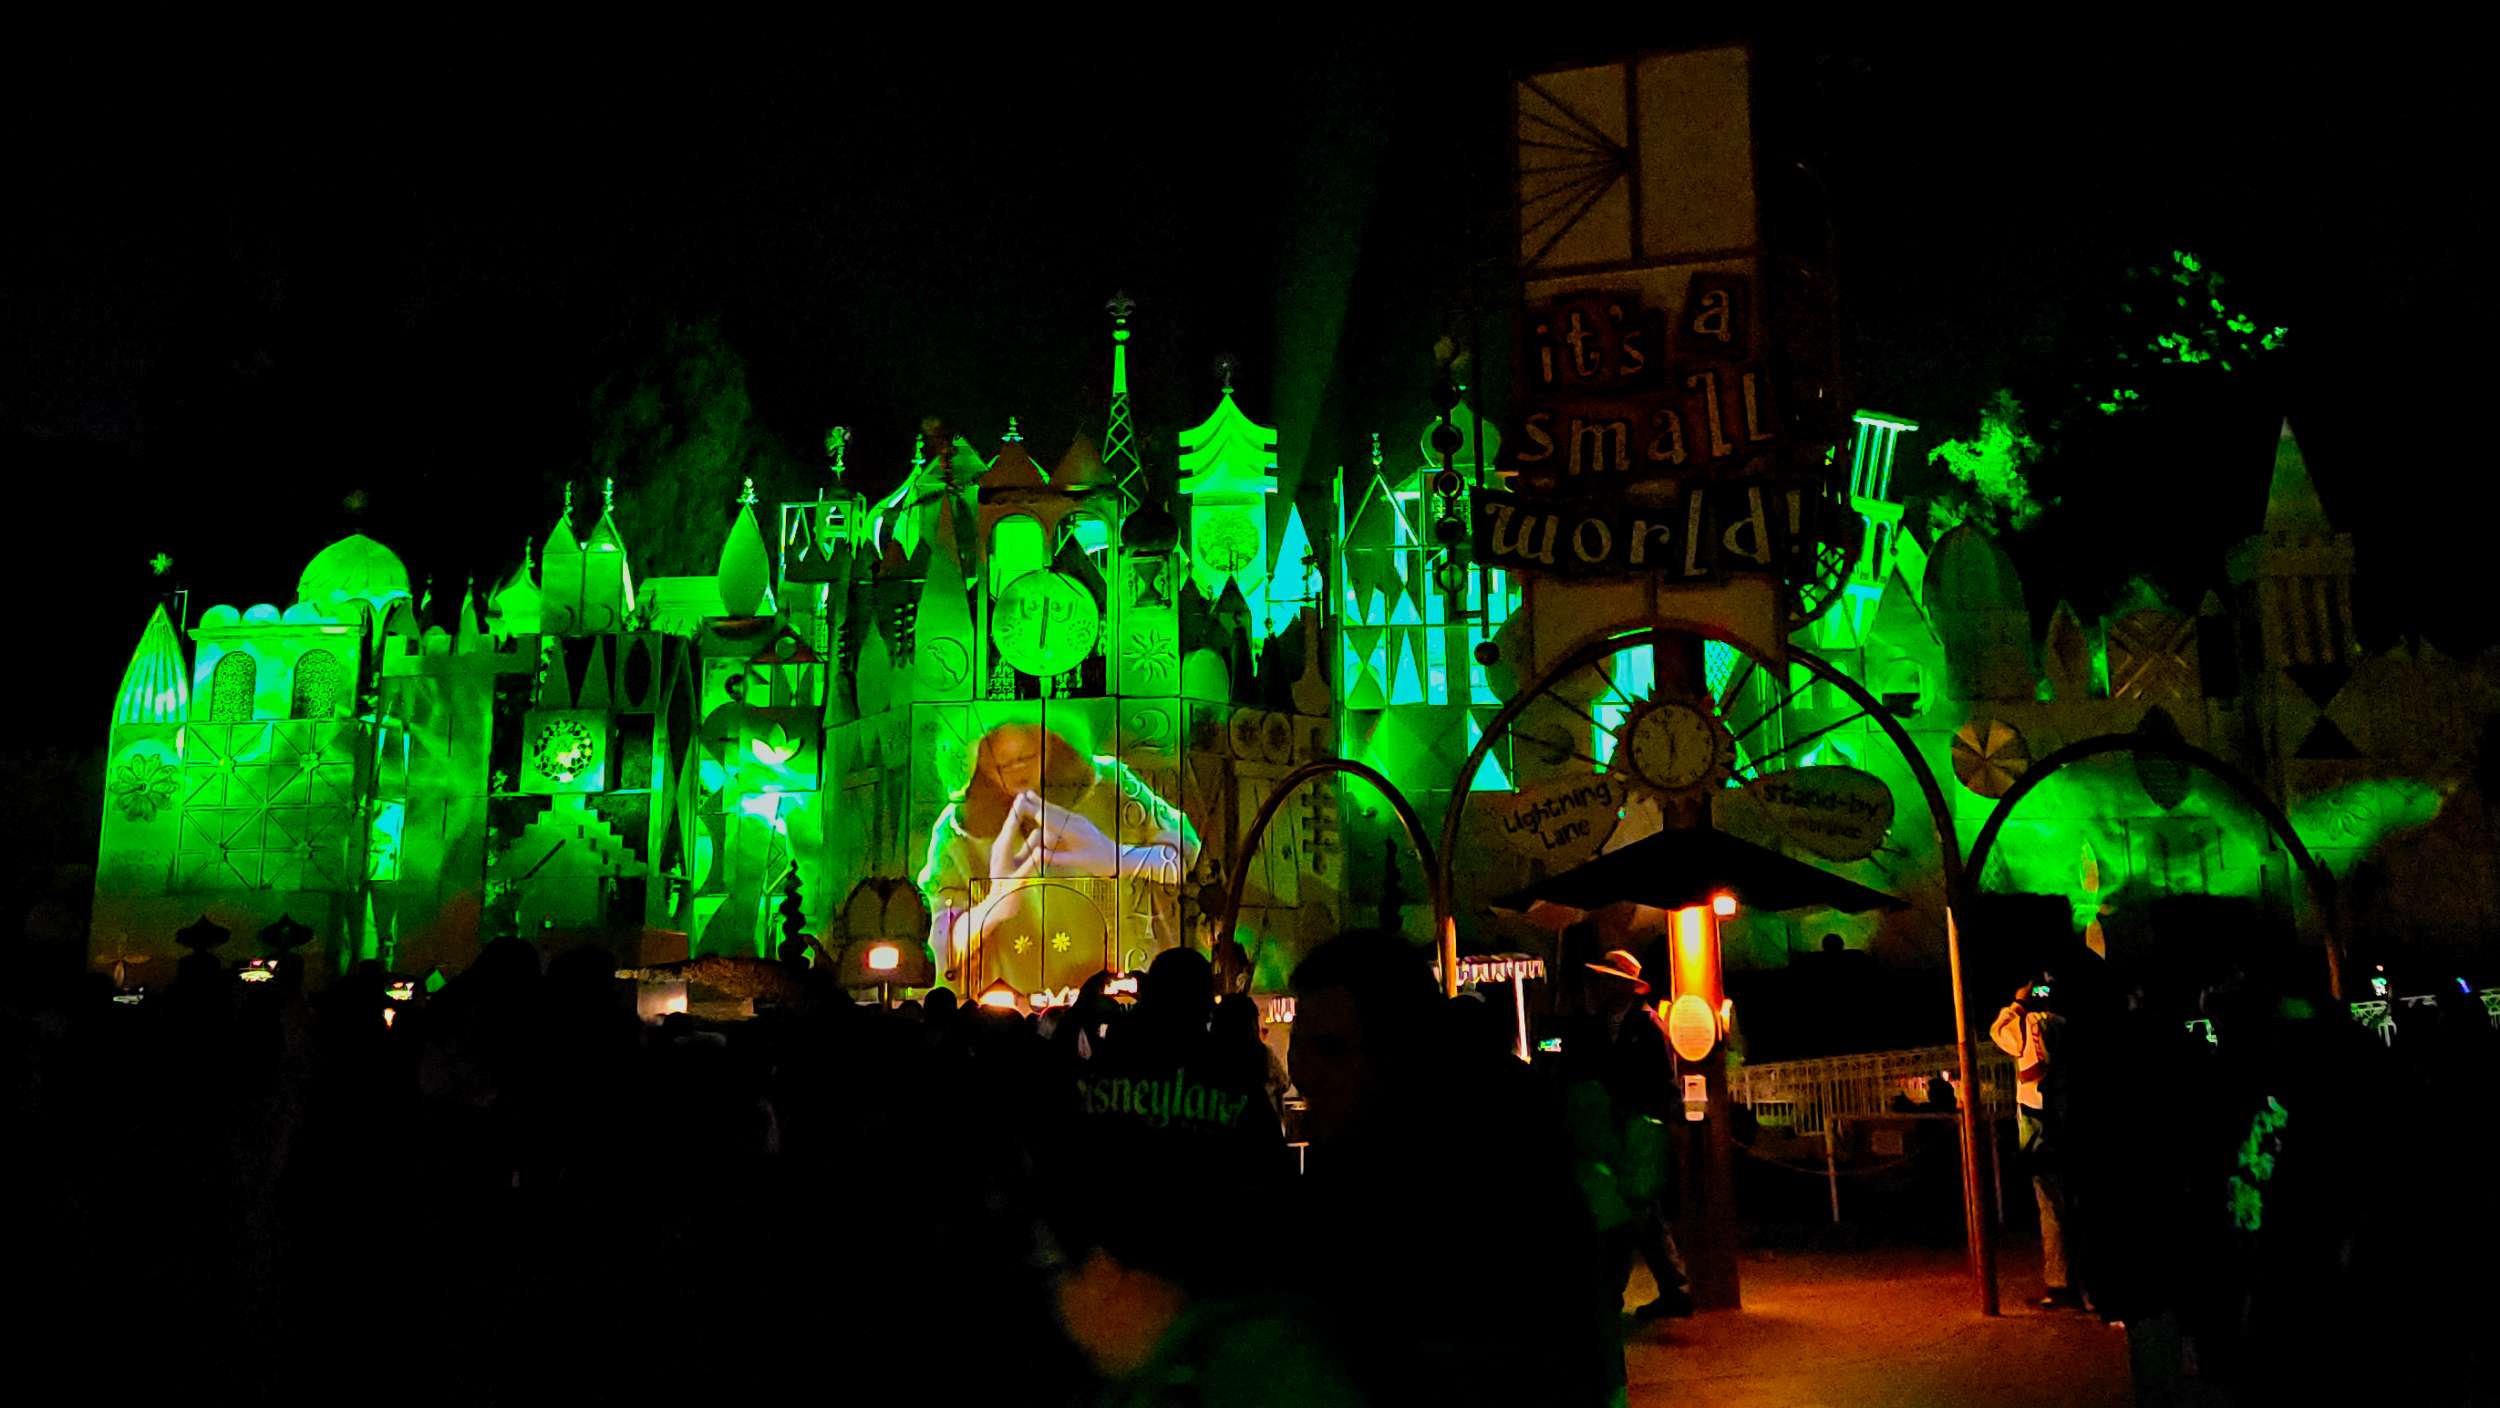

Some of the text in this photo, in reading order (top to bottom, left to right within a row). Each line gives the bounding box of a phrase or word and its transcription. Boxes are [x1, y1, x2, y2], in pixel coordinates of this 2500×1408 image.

[1536, 288, 1734, 384] it's a
[1516, 371, 1775, 477] small
[1484, 484, 1803, 577] world!
[1503, 782, 1613, 834] Lightning
[1540, 820, 1591, 850] Lane
